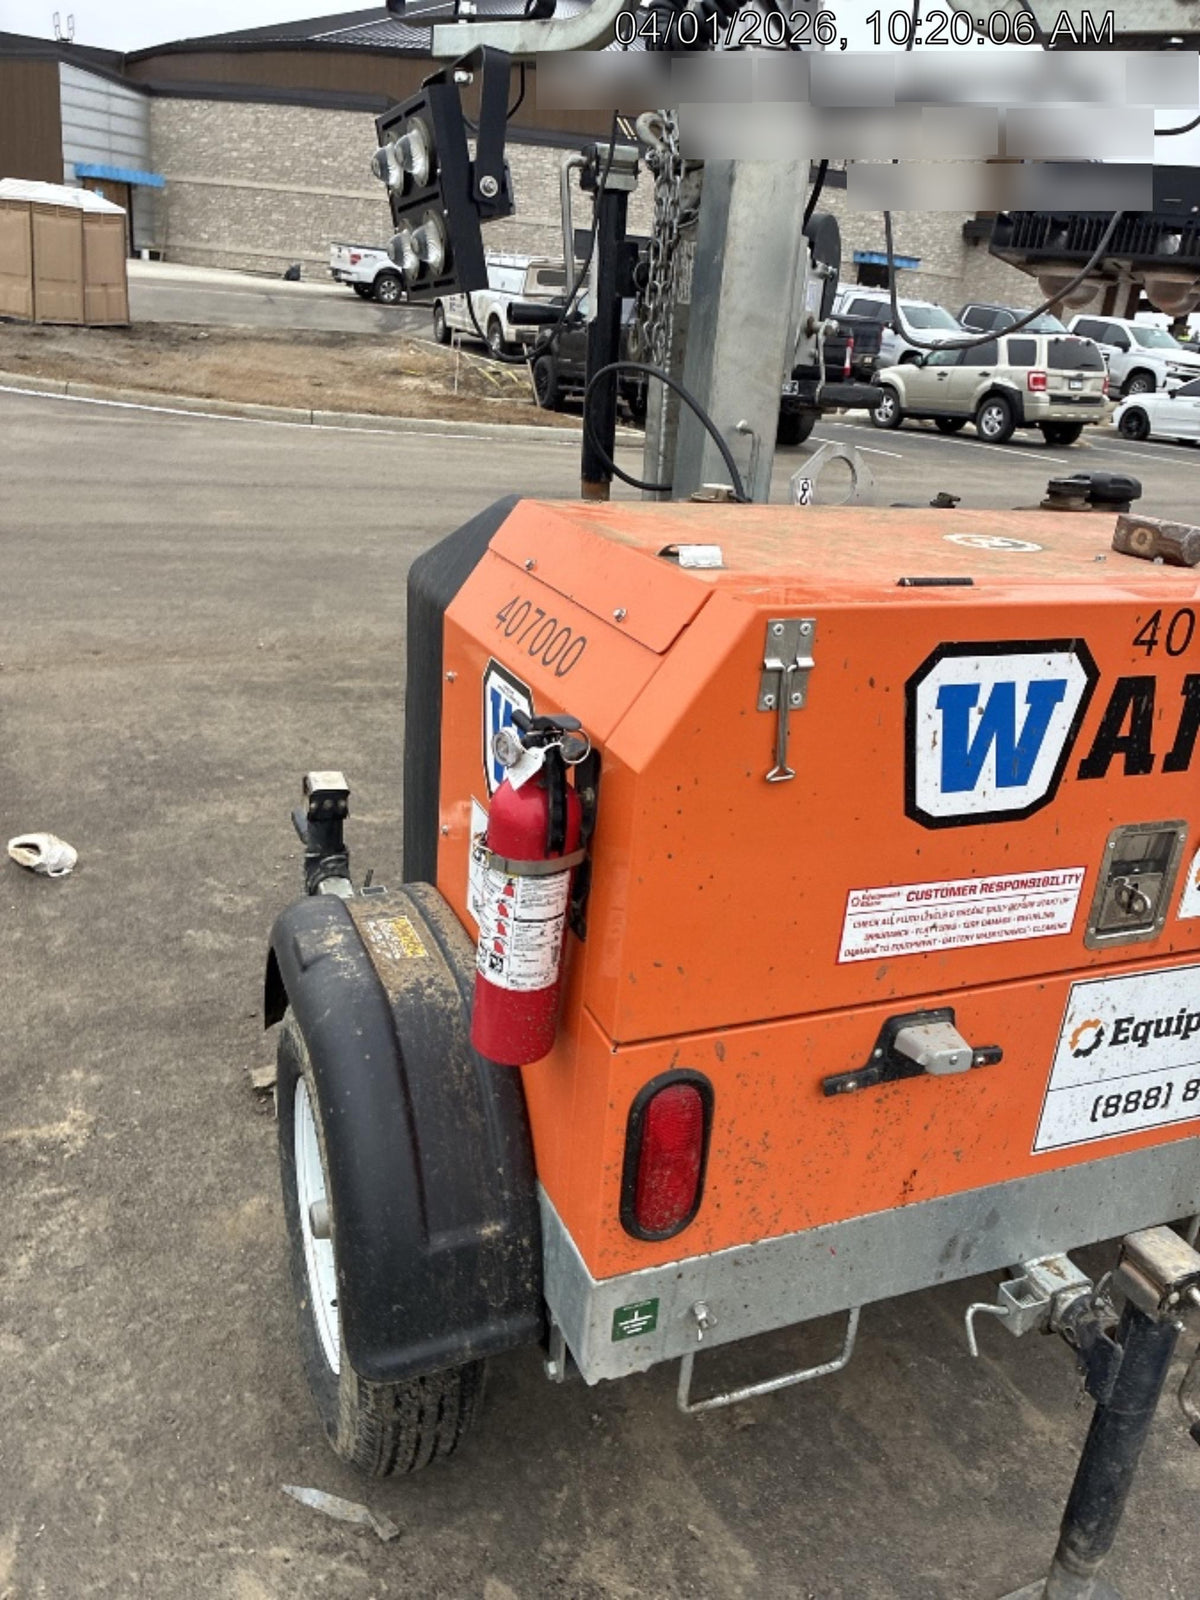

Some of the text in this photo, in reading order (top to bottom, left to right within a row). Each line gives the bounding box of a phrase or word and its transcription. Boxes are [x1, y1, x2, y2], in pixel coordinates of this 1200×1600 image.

[495, 595, 587, 677] 407000
[1132, 608, 1196, 656] 40
[906, 884, 977, 902] CUSTOMER
[980, 873, 1082, 894] RESPONSIBILITY
[1108, 1008, 1200, 1048] Equip
[1089, 1082, 1174, 1122] (888)
